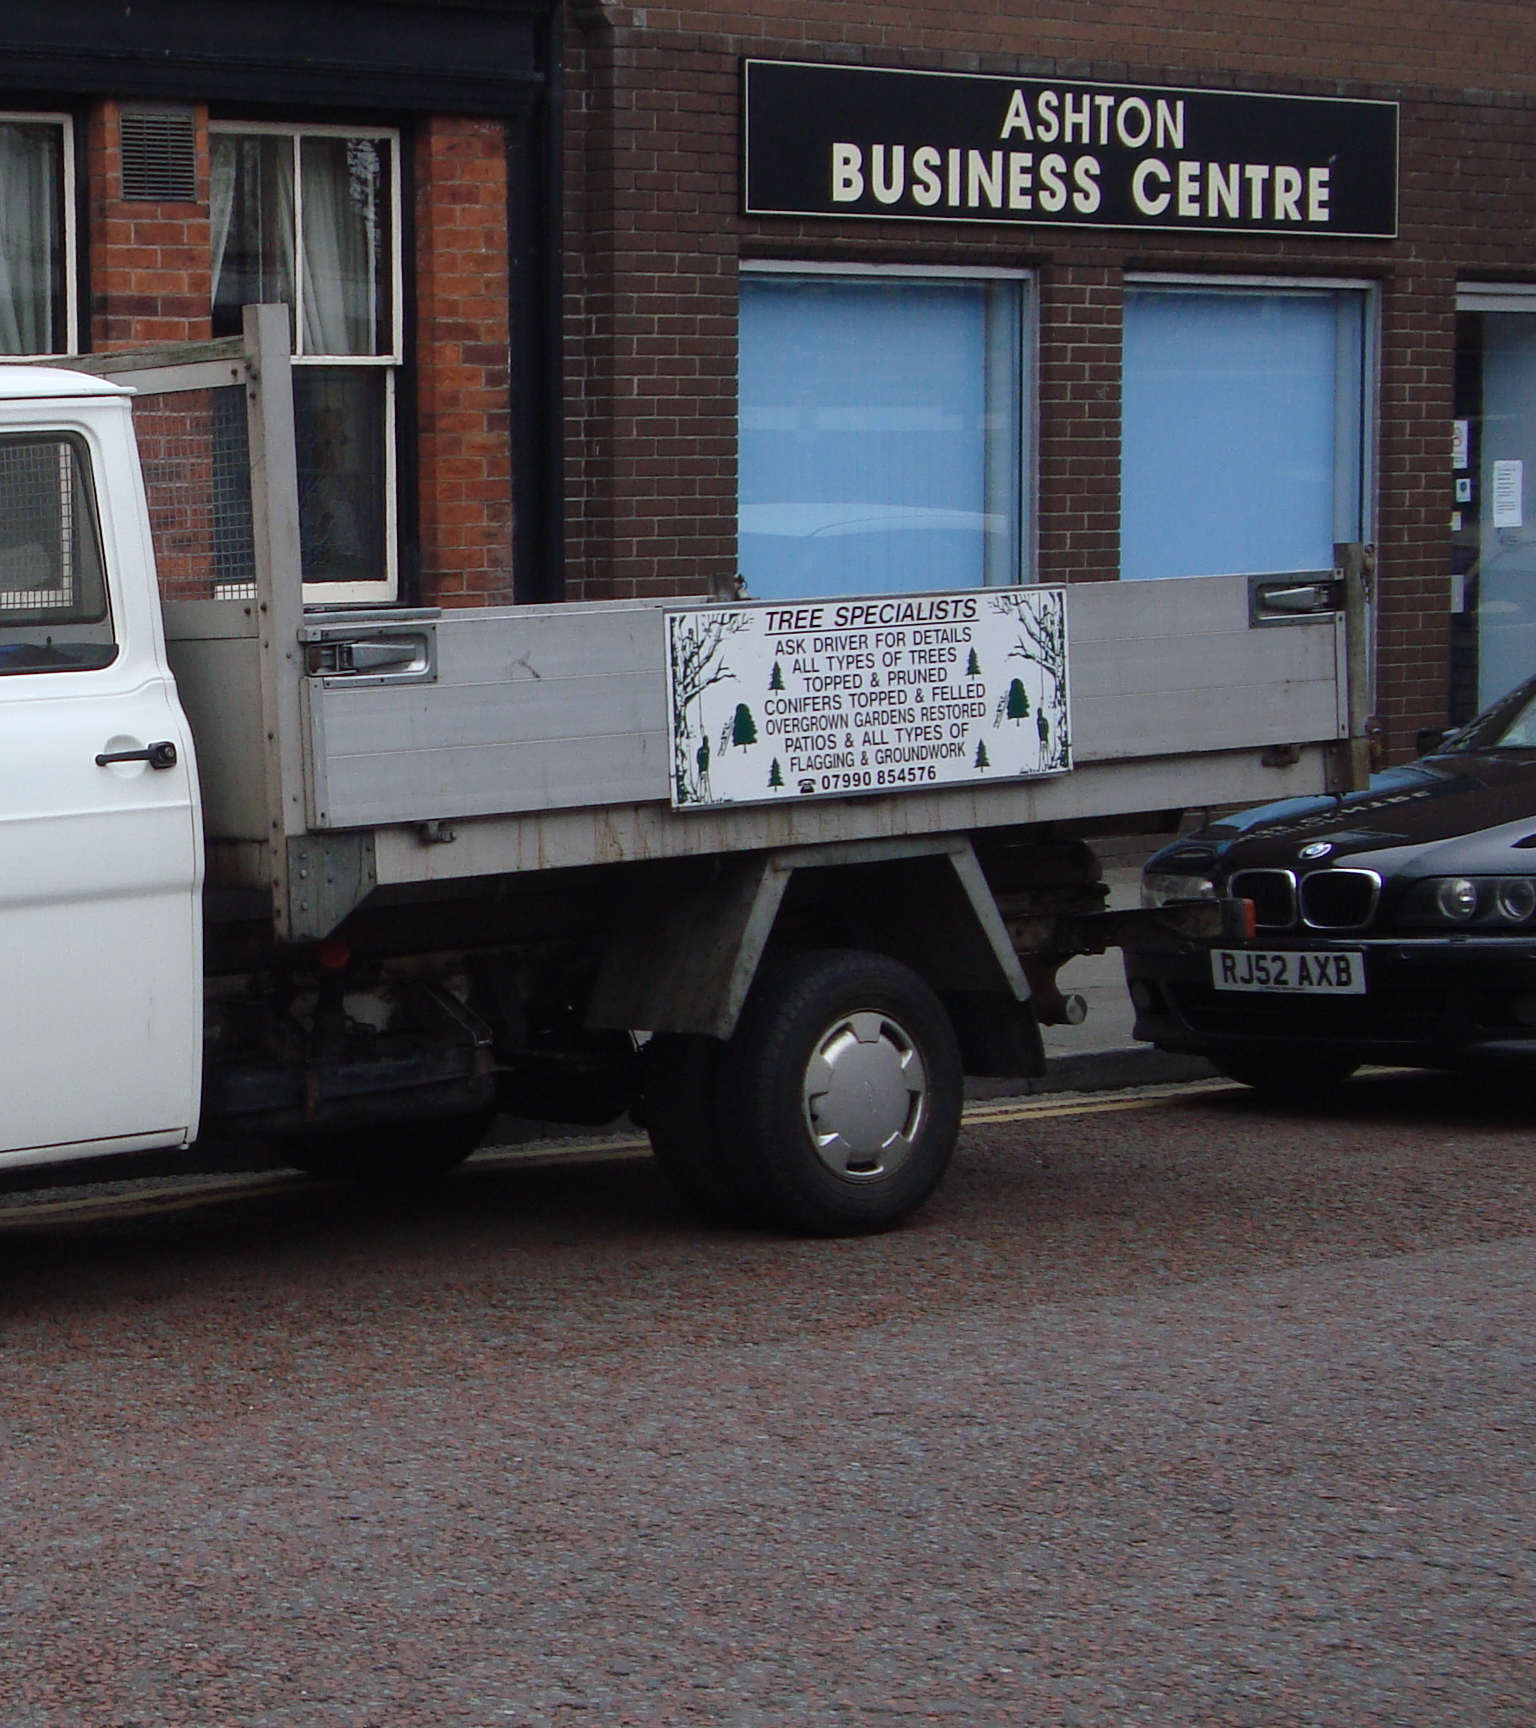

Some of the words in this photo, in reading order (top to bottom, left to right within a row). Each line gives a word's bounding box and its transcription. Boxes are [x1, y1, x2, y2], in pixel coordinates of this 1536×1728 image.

[1001, 88, 1184, 149] ASHTON
[832, 142, 1101, 214] BUSINESS
[1132, 158, 1330, 222] CENTRE
[765, 608, 824, 631] TREE
[834, 598, 977, 627] SPECIALISTS
[775, 639, 806, 656] ASK
[813, 634, 869, 653] DRIVER
[875, 631, 906, 648] FOR
[912, 626, 972, 646] DETAILS
[792, 657, 820, 674] ALL
[826, 652, 875, 671] TYPES
[882, 650, 902, 667] OF
[908, 646, 957, 665] TREES
[803, 673, 863, 693] TOPPED
[870, 672, 880, 688] &
[888, 666, 948, 686] PRUNED
[764, 694, 842, 716] CONIFERS
[848, 689, 908, 709] TOPPED
[915, 688, 924, 704] &
[932, 683, 986, 702] FELLED
[766, 713, 849, 736] OVERGROWN
[854, 707, 916, 728] GARDENS
[921, 702, 986, 722] RESTORED
[785, 733, 837, 753] PATIOS
[845, 732, 854, 749] &
[862, 729, 889, 746] ALL
[895, 724, 943, 744] TYPES
[950, 722, 969, 739] OF
[790, 751, 855, 773] FLAGGING
[861, 750, 869, 766] &
[875, 741, 966, 765] GROUNDWORK
[821, 771, 872, 790] 07990
[877, 765, 937, 785] 854576
[1221, 952, 1289, 985] RJ52
[1298, 955, 1352, 987] AXB
